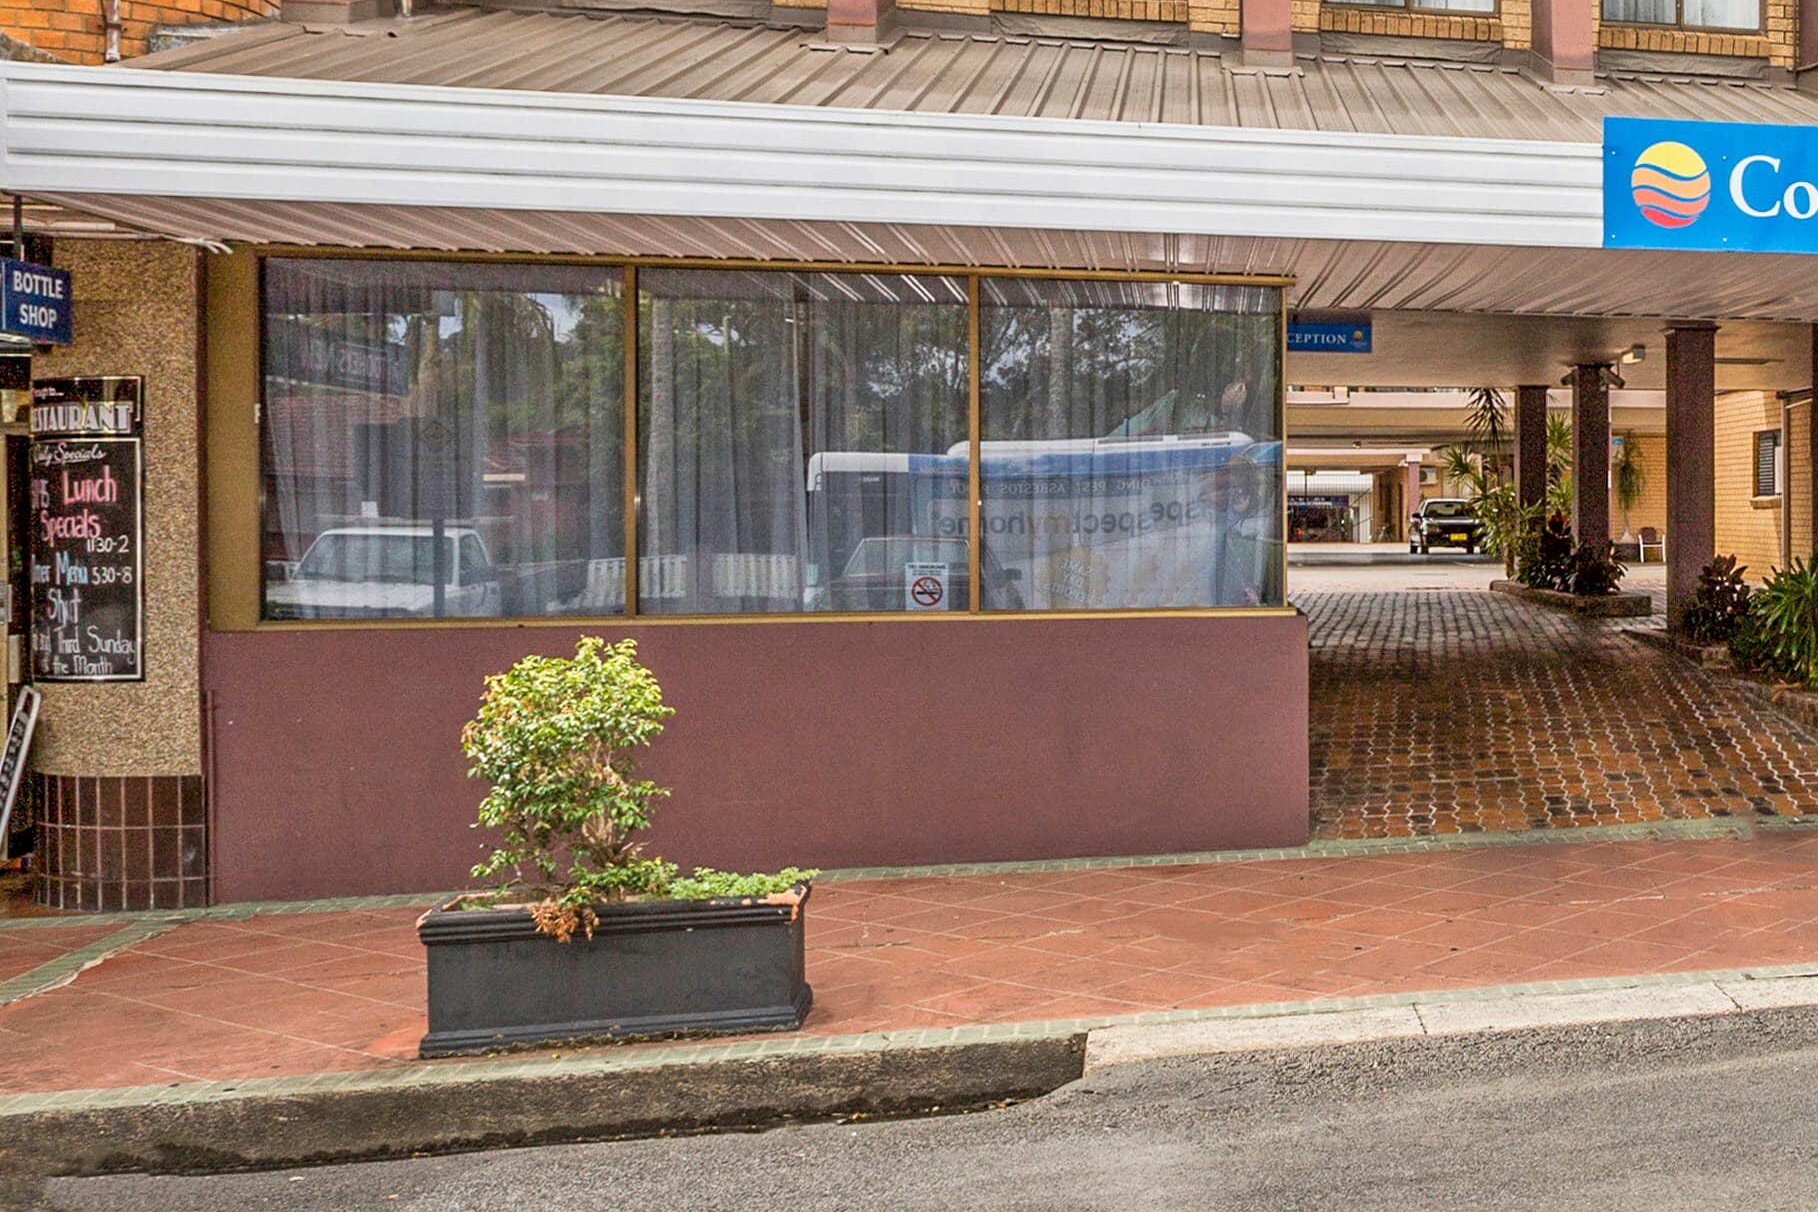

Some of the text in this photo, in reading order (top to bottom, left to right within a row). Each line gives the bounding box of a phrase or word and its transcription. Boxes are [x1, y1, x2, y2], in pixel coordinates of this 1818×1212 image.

[12, 270, 64, 300] BOTTLE
[19, 303, 58, 329] SHOP
[1287, 332, 1347, 345] CEPTION
[54, 442, 107, 464] Specials
[62, 464, 117, 505] Lunch
[87, 625, 137, 665] Sunday
